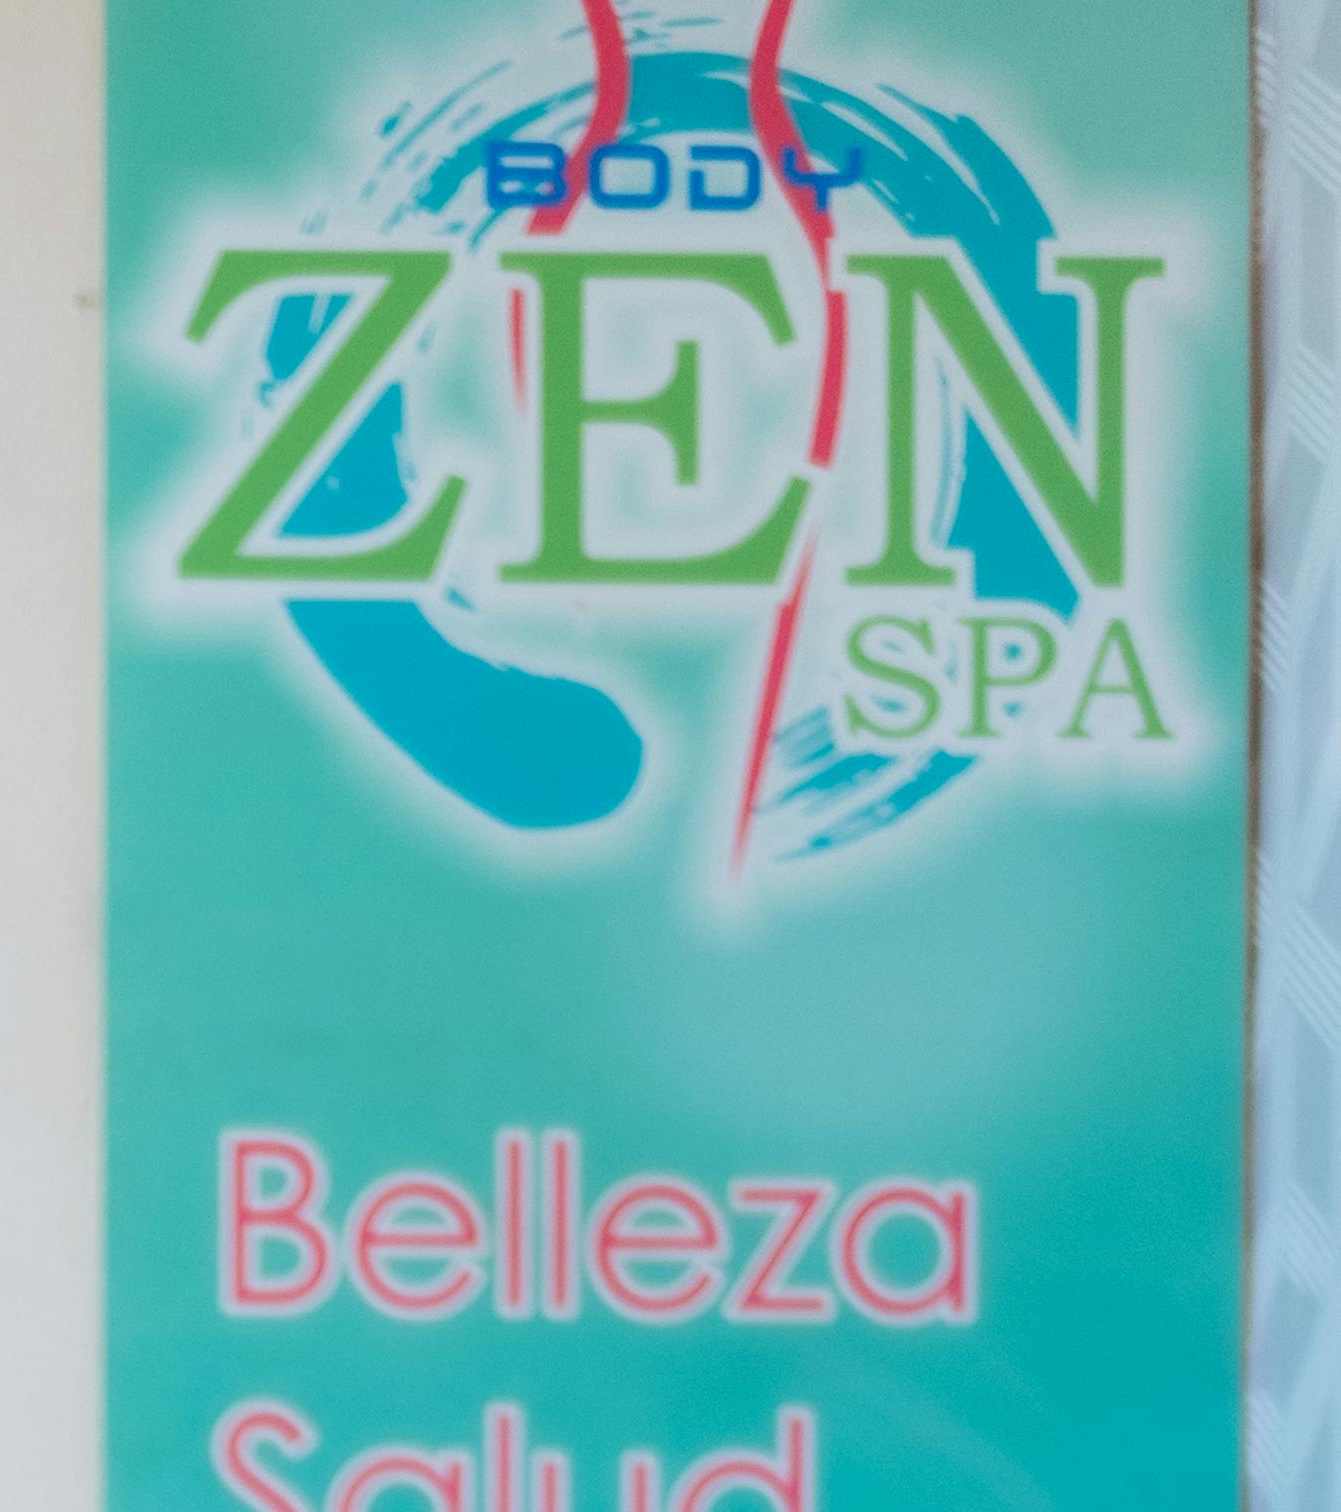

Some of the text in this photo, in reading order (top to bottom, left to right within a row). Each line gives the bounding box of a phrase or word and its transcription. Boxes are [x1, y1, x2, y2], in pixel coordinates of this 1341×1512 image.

[485, 141, 864, 211] BODY
[177, 251, 1164, 588] ZEN
[844, 616, 1175, 741] SPA
[220, 1128, 978, 1322] Belleza
